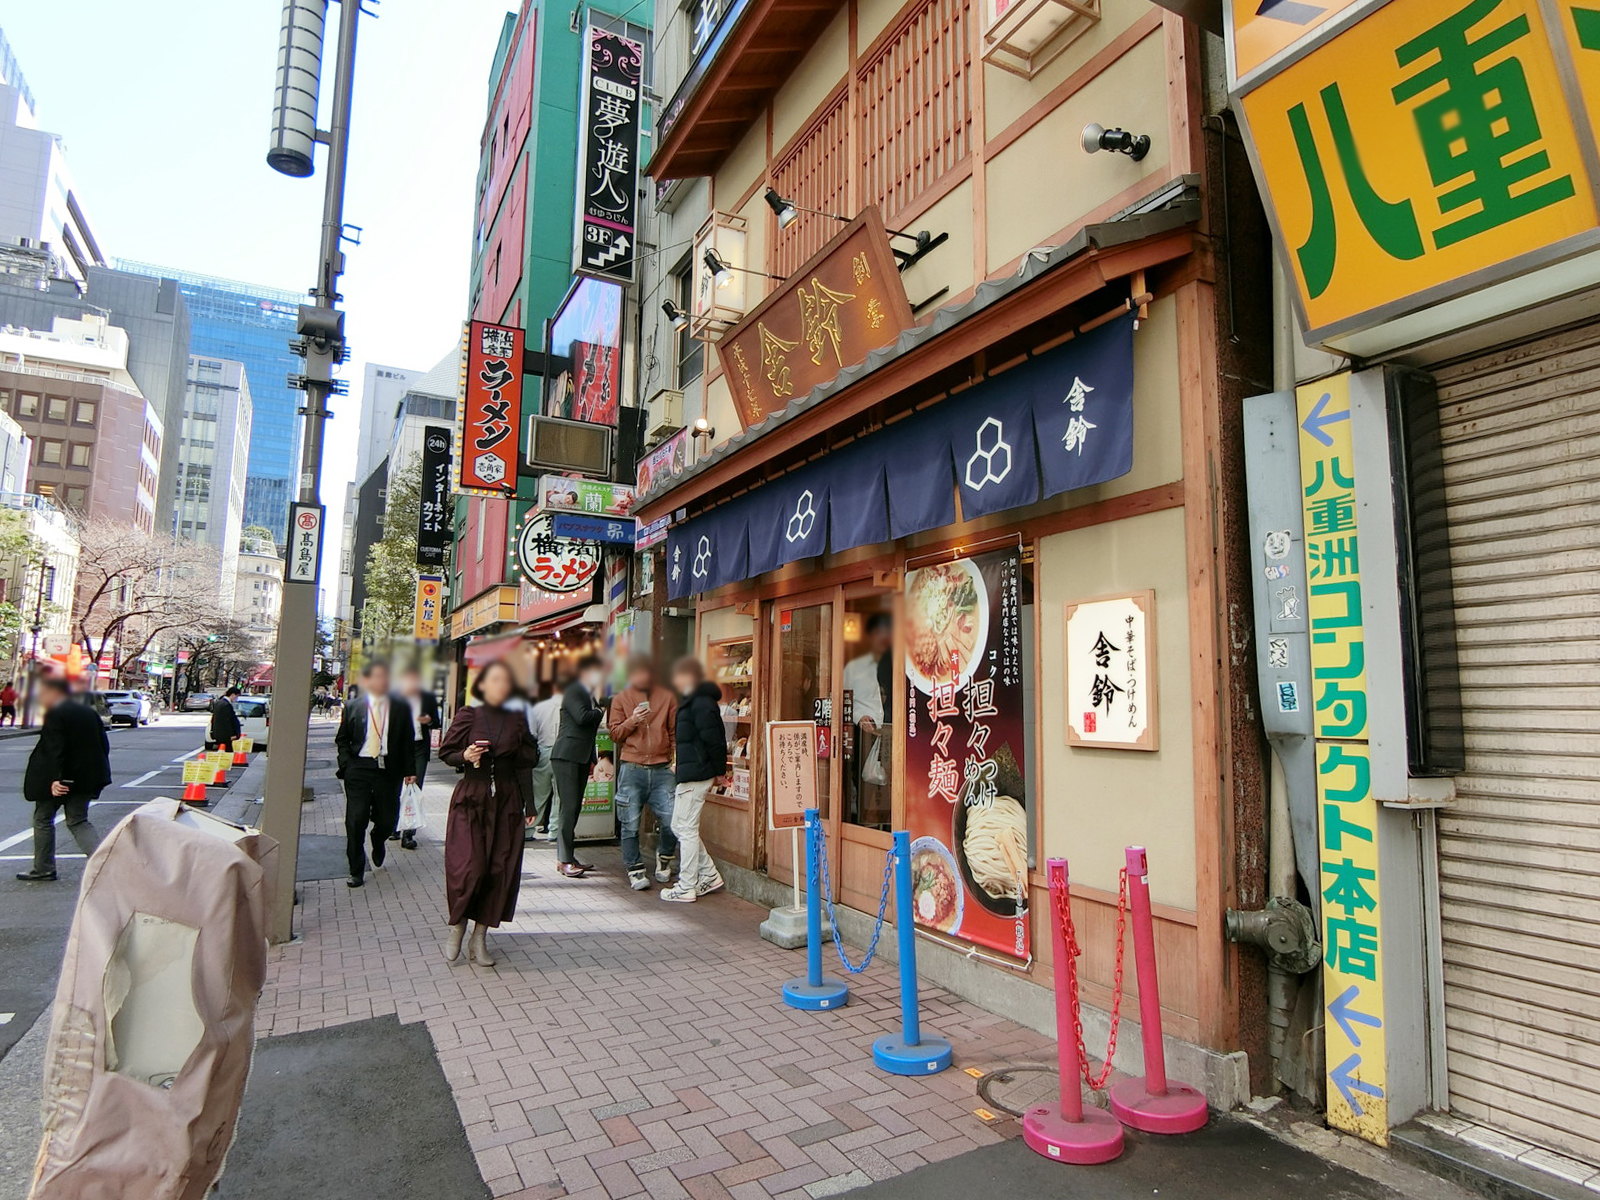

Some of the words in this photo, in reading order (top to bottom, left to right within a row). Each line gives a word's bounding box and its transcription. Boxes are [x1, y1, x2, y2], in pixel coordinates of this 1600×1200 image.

[595, 79, 634, 99] CLUB
[590, 94, 631, 205] 夢遊人
[1287, 0, 1576, 300] 八重
[586, 226, 611, 244] 3F
[473, 360, 514, 450] ラーメン
[1062, 376, 1097, 456] 舎鈴
[429, 438, 445, 449] 24h
[423, 502, 433, 531] カフェ
[434, 463, 446, 532] インターネット
[534, 557, 597, 586] ラーメン
[423, 598, 435, 620] 松屋
[1001, 560, 1011, 686] つけめん専門店ならではの味
[1009, 557, 1020, 684] 担々麺専門店では味わえない
[951, 652, 960, 680] キレ
[989, 650, 998, 678] コク
[1088, 631, 1126, 718] 舎鈴
[814, 698, 832, 718] 2階
[927, 675, 960, 803] 担々麺
[1303, 456, 1378, 981] 八重洲コンタクト本店
